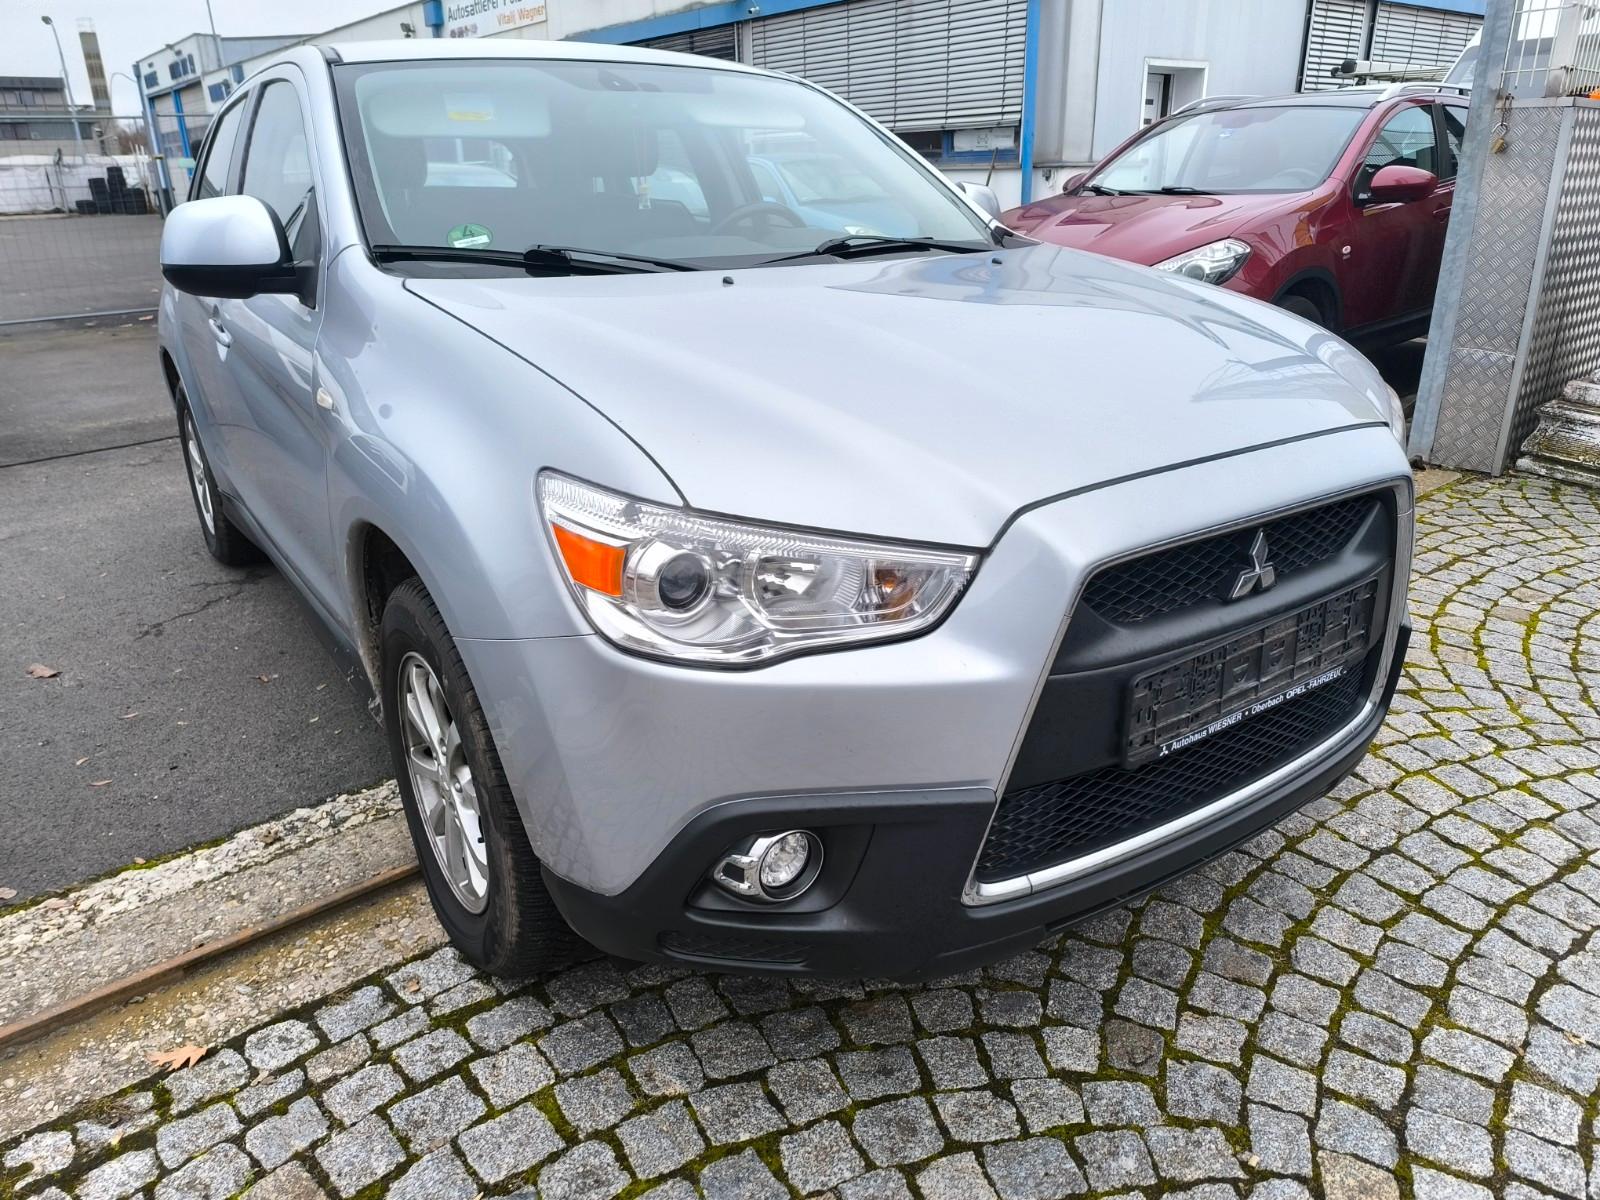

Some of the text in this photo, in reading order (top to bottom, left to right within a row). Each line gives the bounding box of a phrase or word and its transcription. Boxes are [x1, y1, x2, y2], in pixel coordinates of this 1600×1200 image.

[518, 5, 545, 21] Wagner
[1171, 729, 1207, 751] Autohaus
[1208, 712, 1243, 734] WIESNER
[1251, 695, 1284, 714] Oberbach
